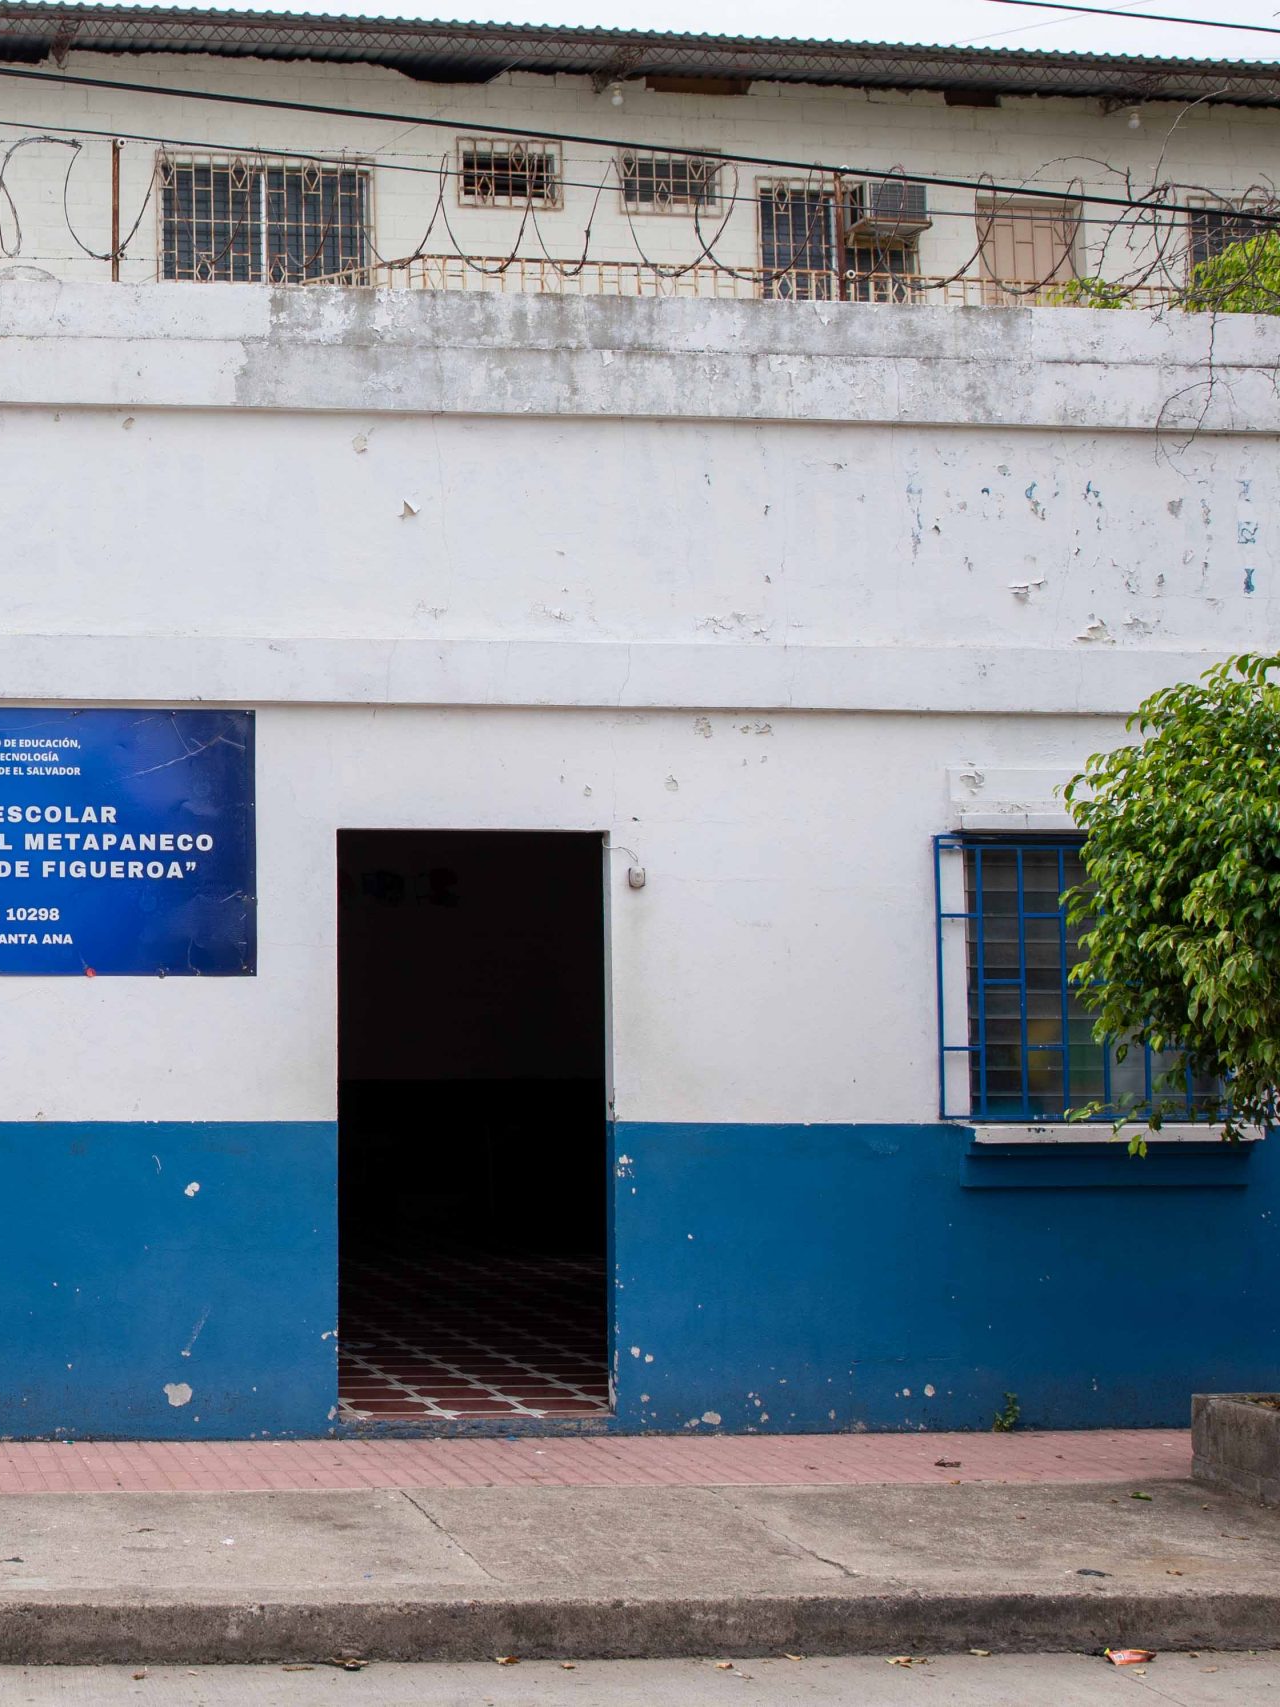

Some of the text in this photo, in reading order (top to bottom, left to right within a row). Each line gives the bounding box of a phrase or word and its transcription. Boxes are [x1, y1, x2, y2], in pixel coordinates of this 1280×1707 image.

[3, 738, 17, 748] DE
[19, 737, 81, 749] EDUCACIÓN,
[13, 766, 24, 776] EL
[26, 766, 81, 776] SALVADOR
[24, 833, 214, 852] METAPANECO
[42, 861, 197, 879] FIGUEROA”
[6, 907, 60, 921] 10298
[42, 933, 73, 945] ANA
